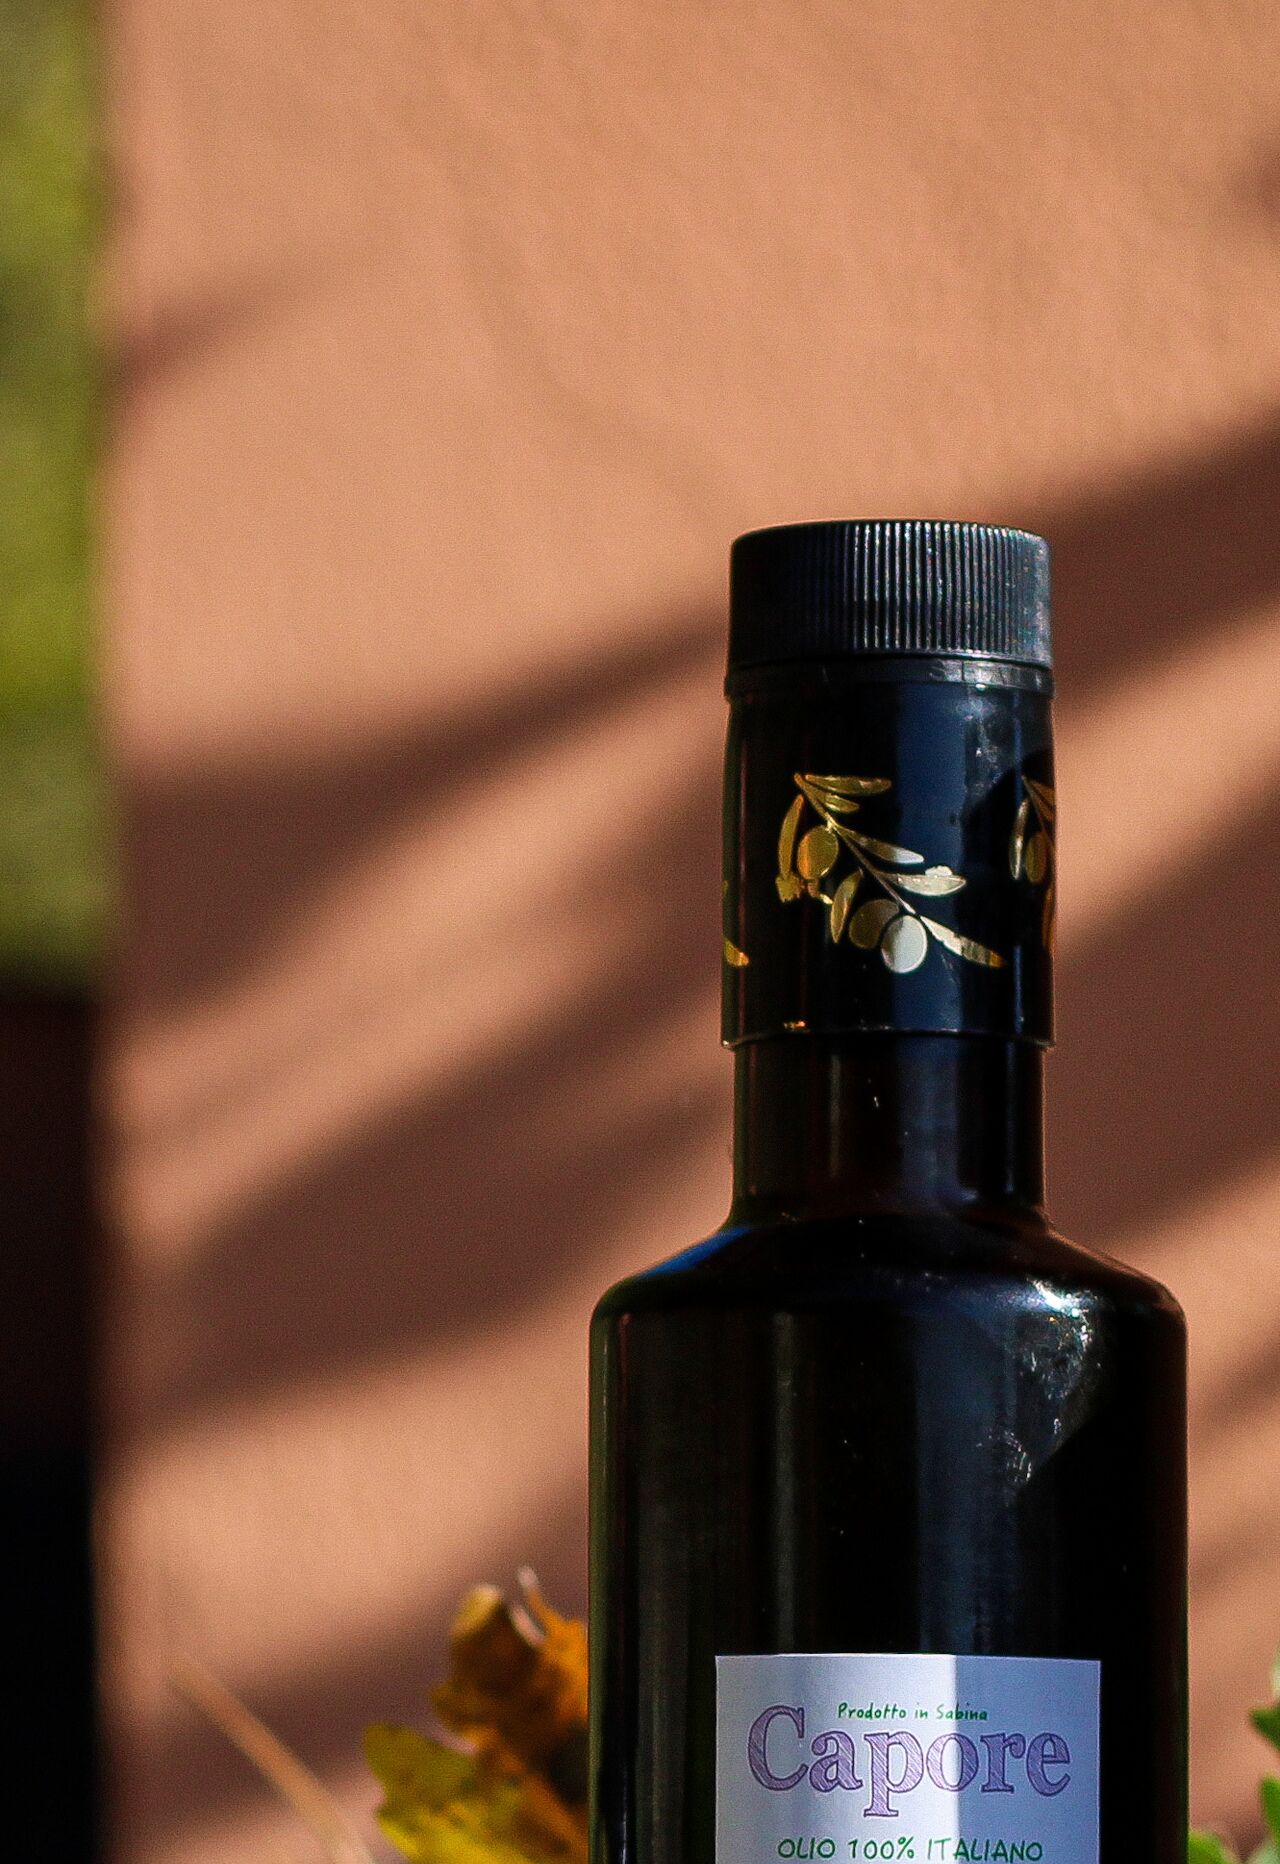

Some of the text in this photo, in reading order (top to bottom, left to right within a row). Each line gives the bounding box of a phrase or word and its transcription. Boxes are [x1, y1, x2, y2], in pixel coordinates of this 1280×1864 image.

[837, 1702, 988, 1721] Prodotto in Sabina
[747, 1704, 1071, 1818] Capore
[777, 1836, 1044, 1864] OLIO 100% ITALIANO
